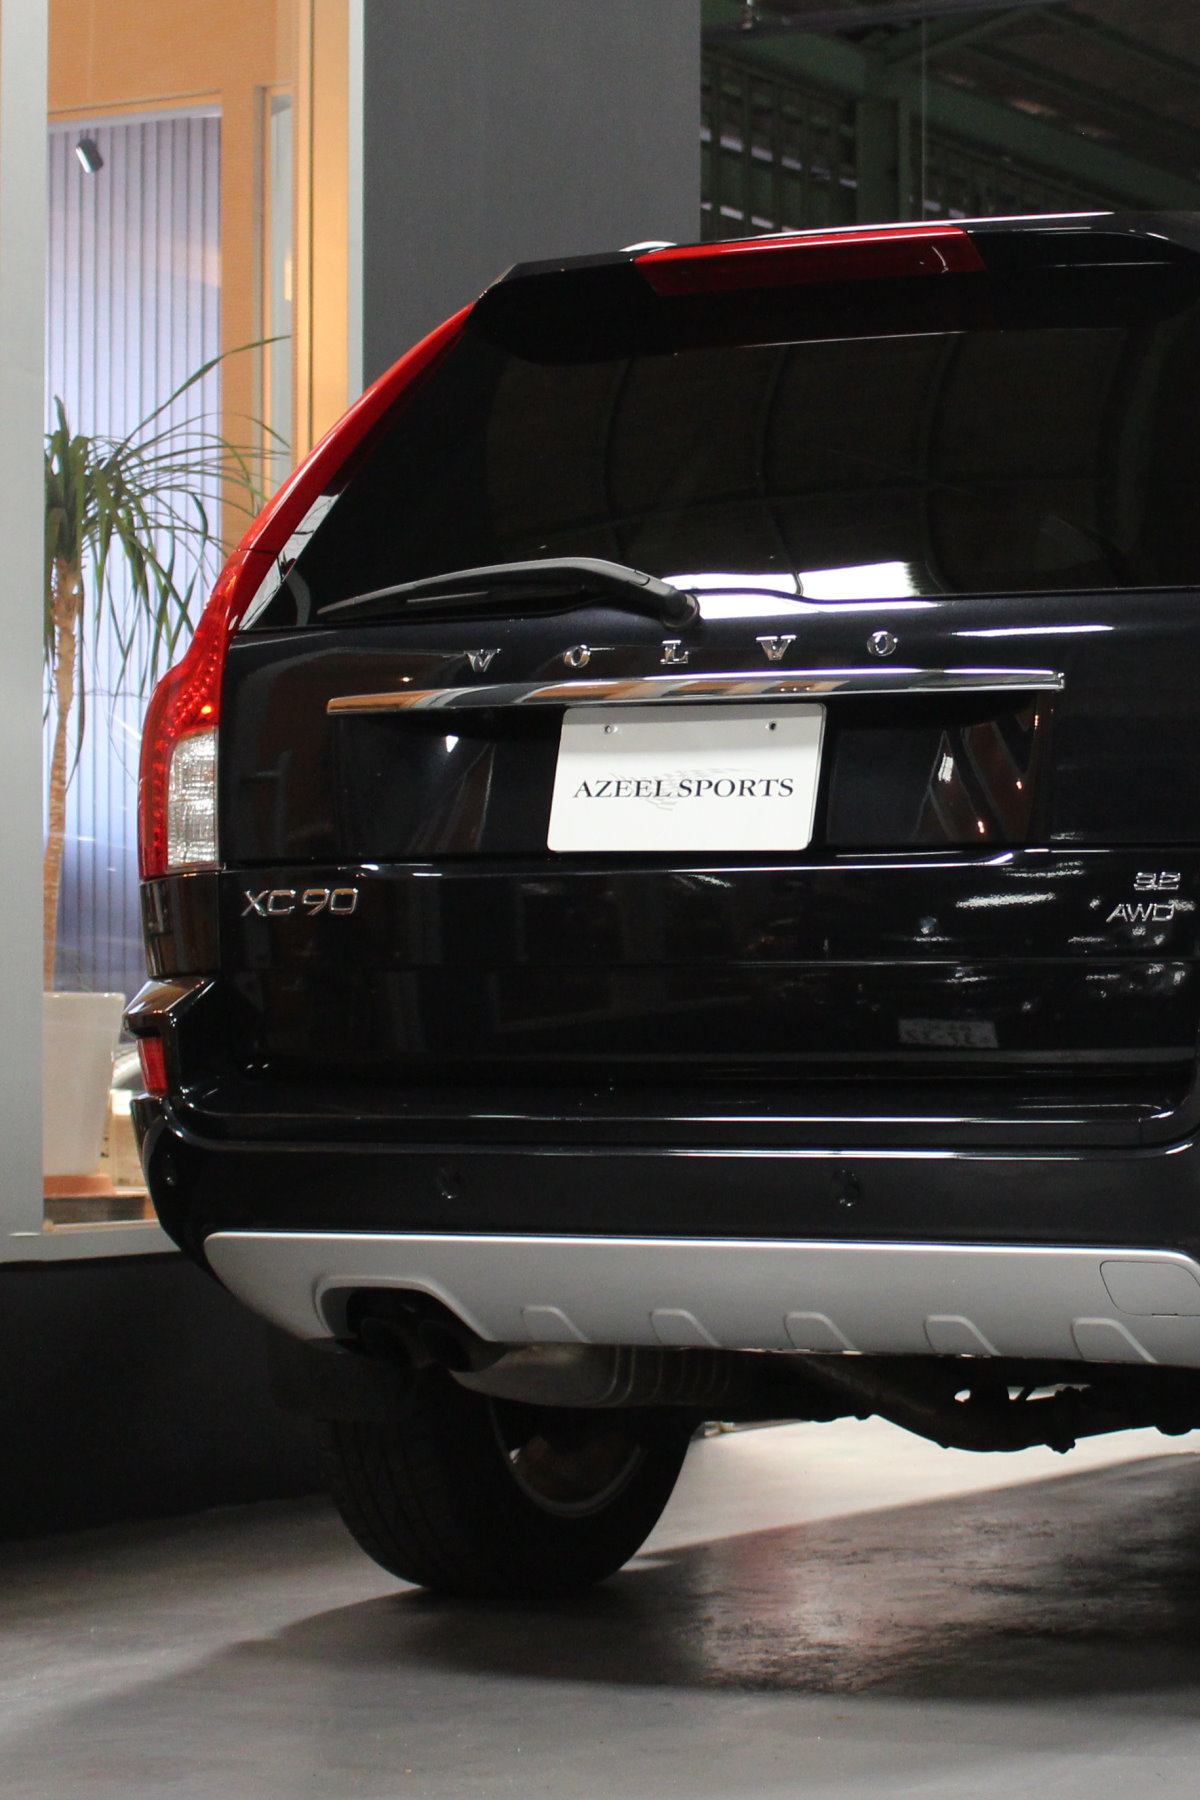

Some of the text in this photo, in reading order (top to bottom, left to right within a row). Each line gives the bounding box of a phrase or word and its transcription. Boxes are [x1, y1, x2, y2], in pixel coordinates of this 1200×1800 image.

[465, 630, 898, 673] VOLVO
[573, 778, 795, 799] AZEEL SPORTS
[1106, 902, 1175, 923] AWD
